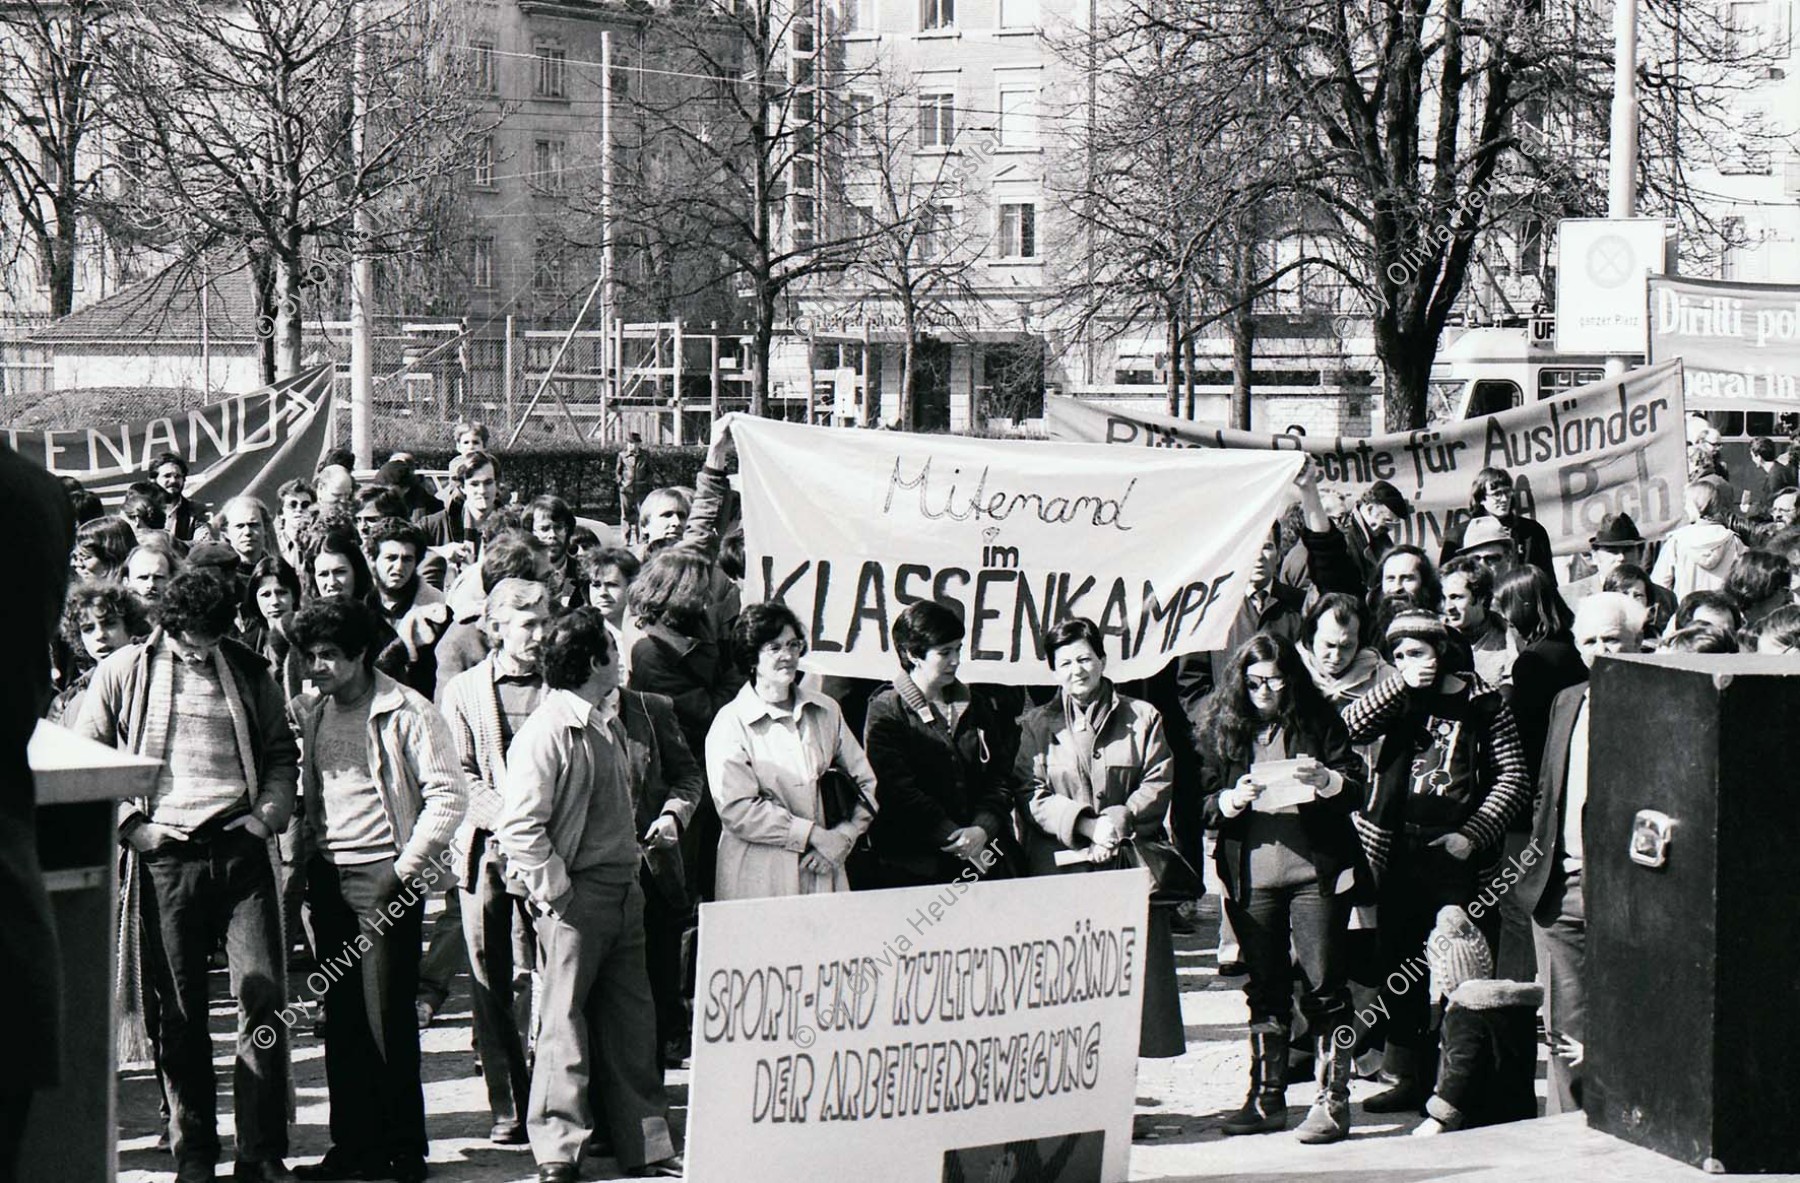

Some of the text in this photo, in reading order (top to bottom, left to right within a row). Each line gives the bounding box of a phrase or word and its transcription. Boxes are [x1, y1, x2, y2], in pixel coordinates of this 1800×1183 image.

[1403, 428, 1467, 489] für
[1483, 382, 1668, 469] Ausländer
[884, 455, 1137, 530] Mitenand
[982, 545, 1019, 568] im
[761, 556, 1234, 663] KLASSENKAMPF
[892, 919, 1137, 1026] KULTURVERBÄNDE
[752, 1021, 1102, 1125] DER ARBEITERBEWEGUNG
